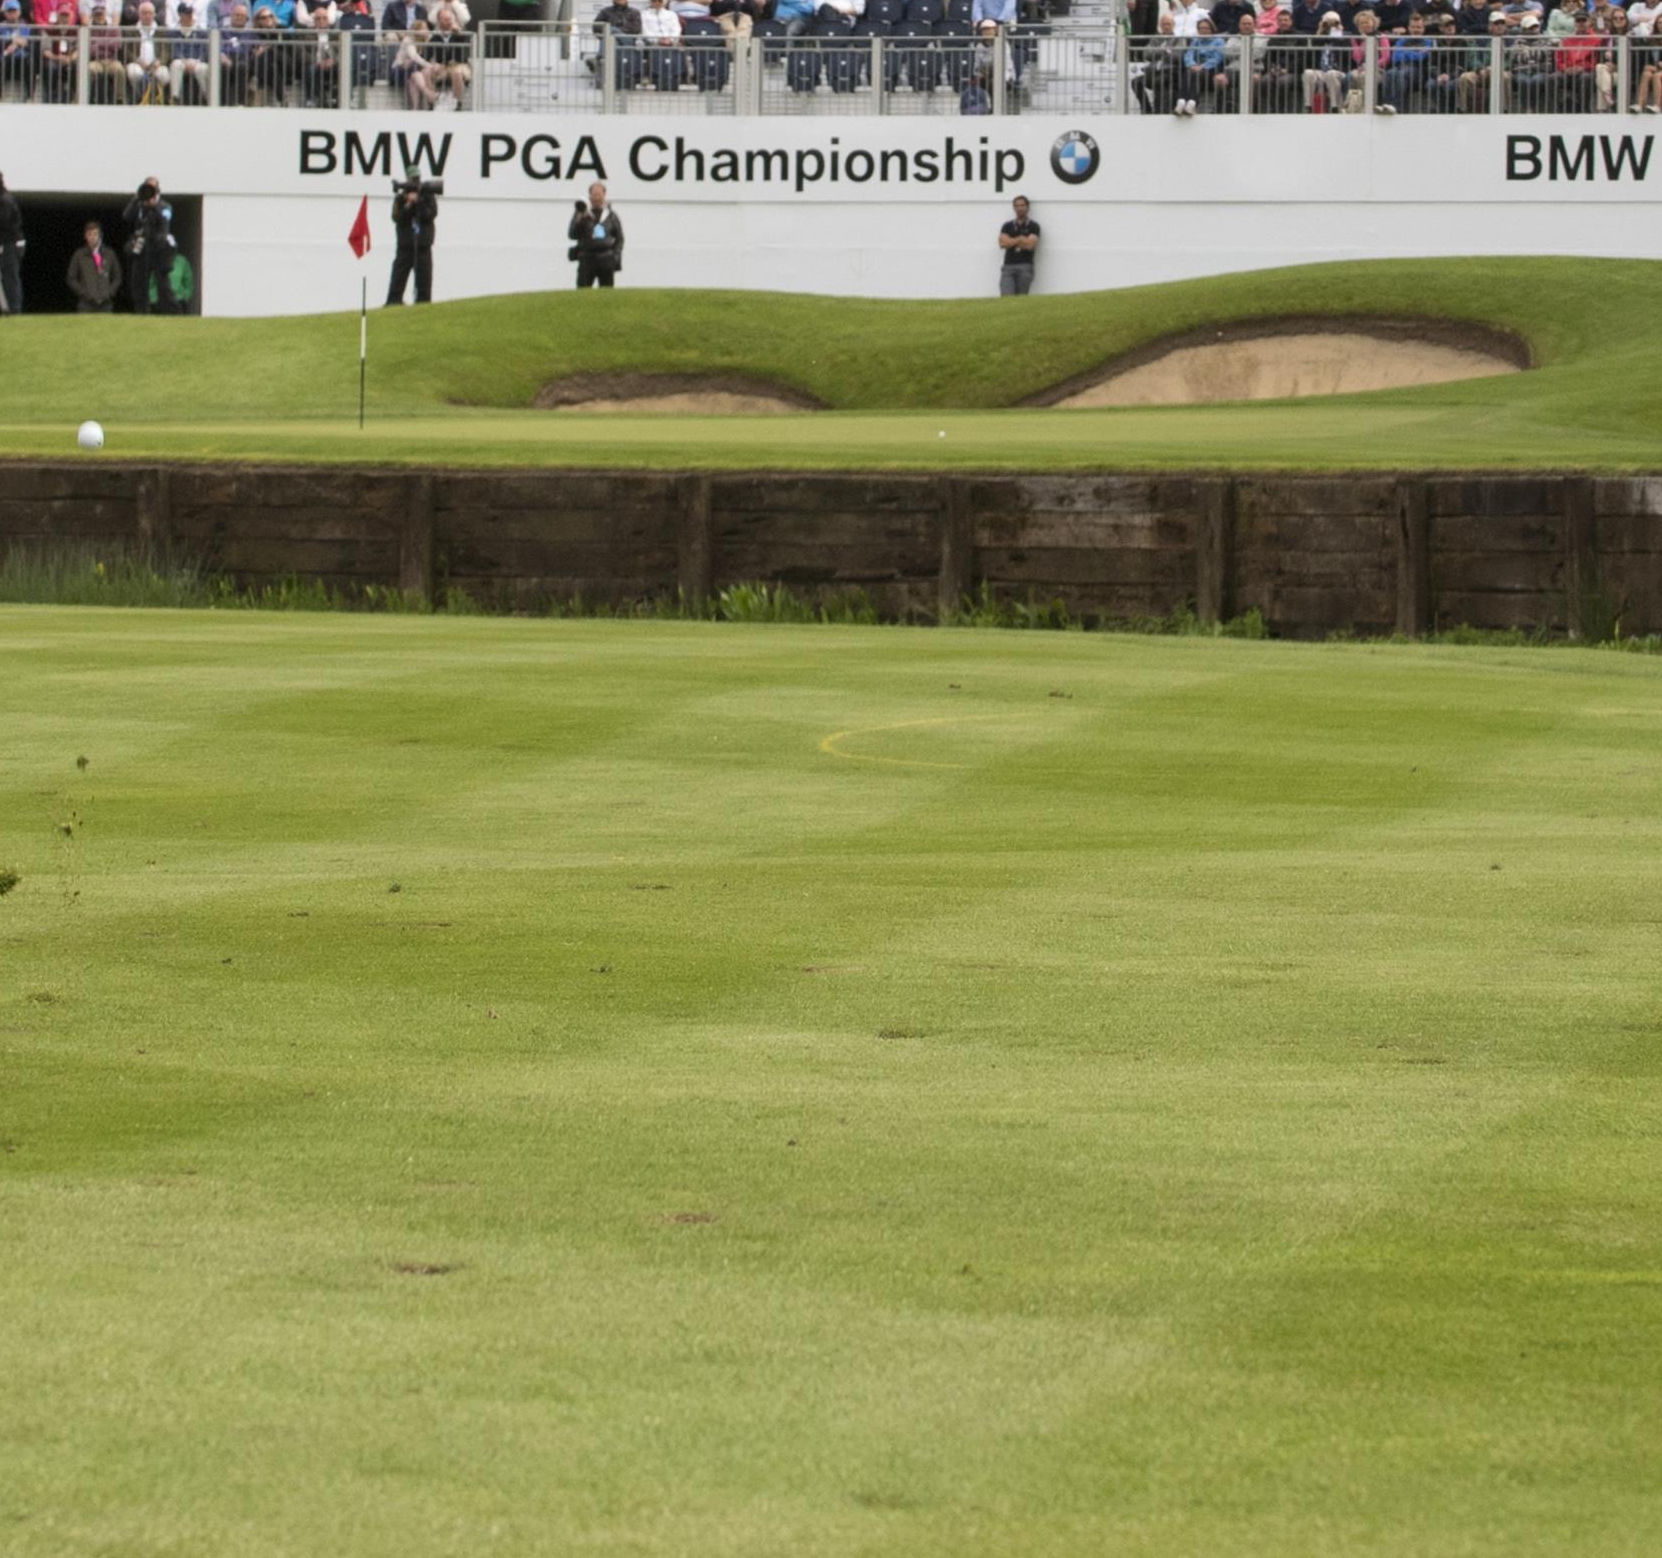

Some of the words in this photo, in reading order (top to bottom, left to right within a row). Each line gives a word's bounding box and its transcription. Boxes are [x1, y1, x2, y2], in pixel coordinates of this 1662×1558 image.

[299, 129, 453, 177] BMW
[480, 133, 608, 181] PGA
[628, 134, 1026, 193] Championship
[1505, 135, 1655, 182] BMW
